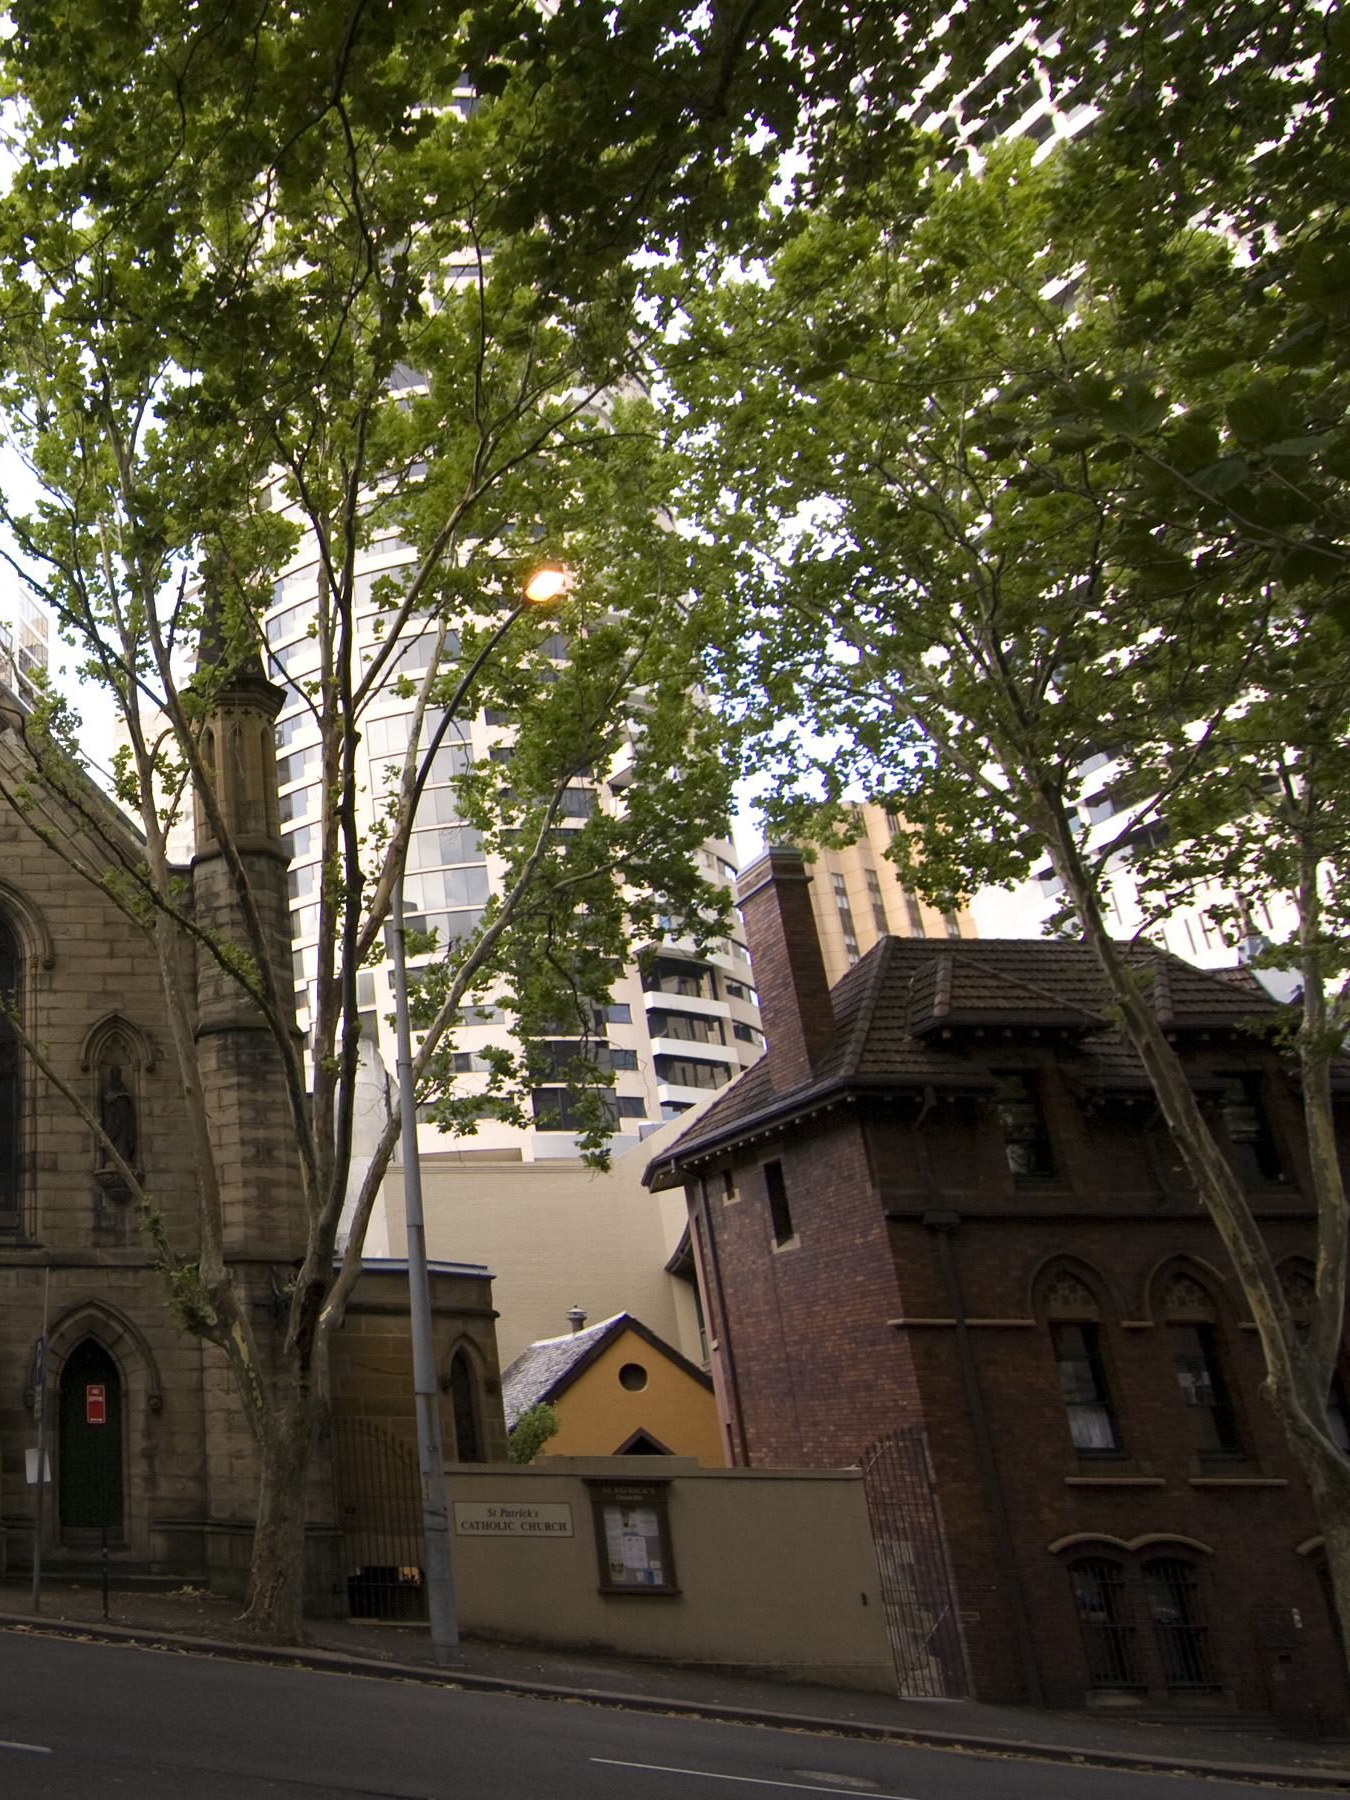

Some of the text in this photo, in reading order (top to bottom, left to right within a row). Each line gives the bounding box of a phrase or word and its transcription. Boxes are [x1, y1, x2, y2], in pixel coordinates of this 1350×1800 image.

[500, 1508, 539, 1518] Patrick's
[461, 1520, 567, 1532] CATHOLIC CHURCH
